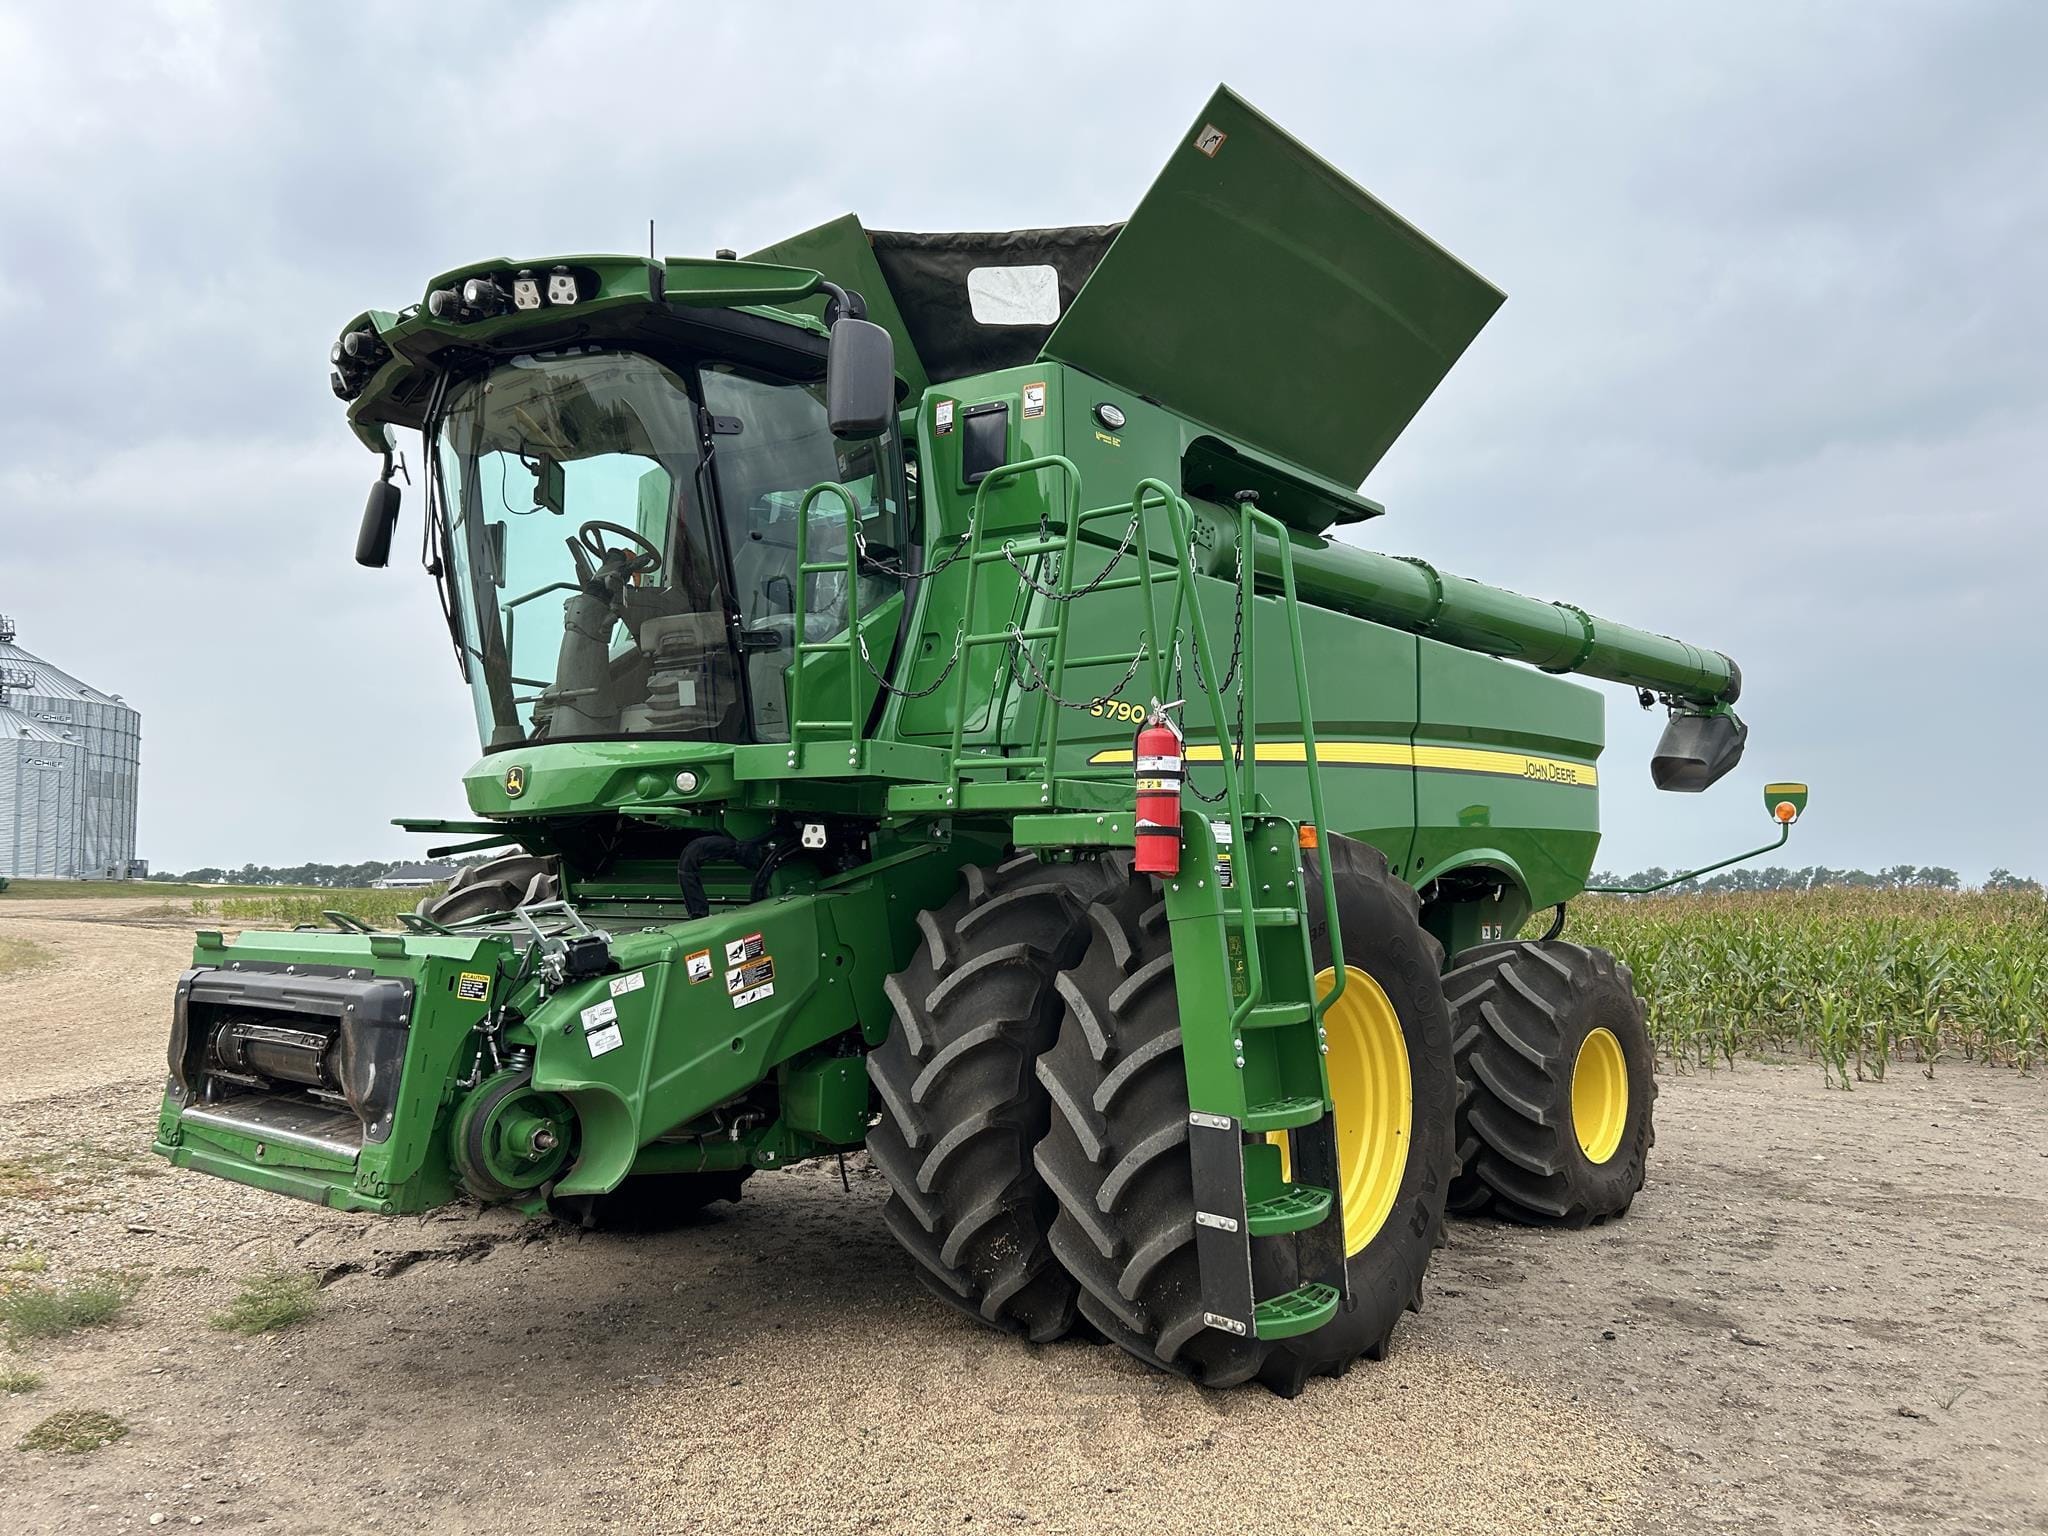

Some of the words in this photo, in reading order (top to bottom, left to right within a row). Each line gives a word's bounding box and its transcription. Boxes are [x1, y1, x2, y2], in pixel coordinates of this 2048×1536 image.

[1090, 697, 1146, 724] S790
[34, 759, 63, 767] CHIEF
[1523, 760, 1548, 779] JOHN
[1548, 763, 1577, 783] DEERE
